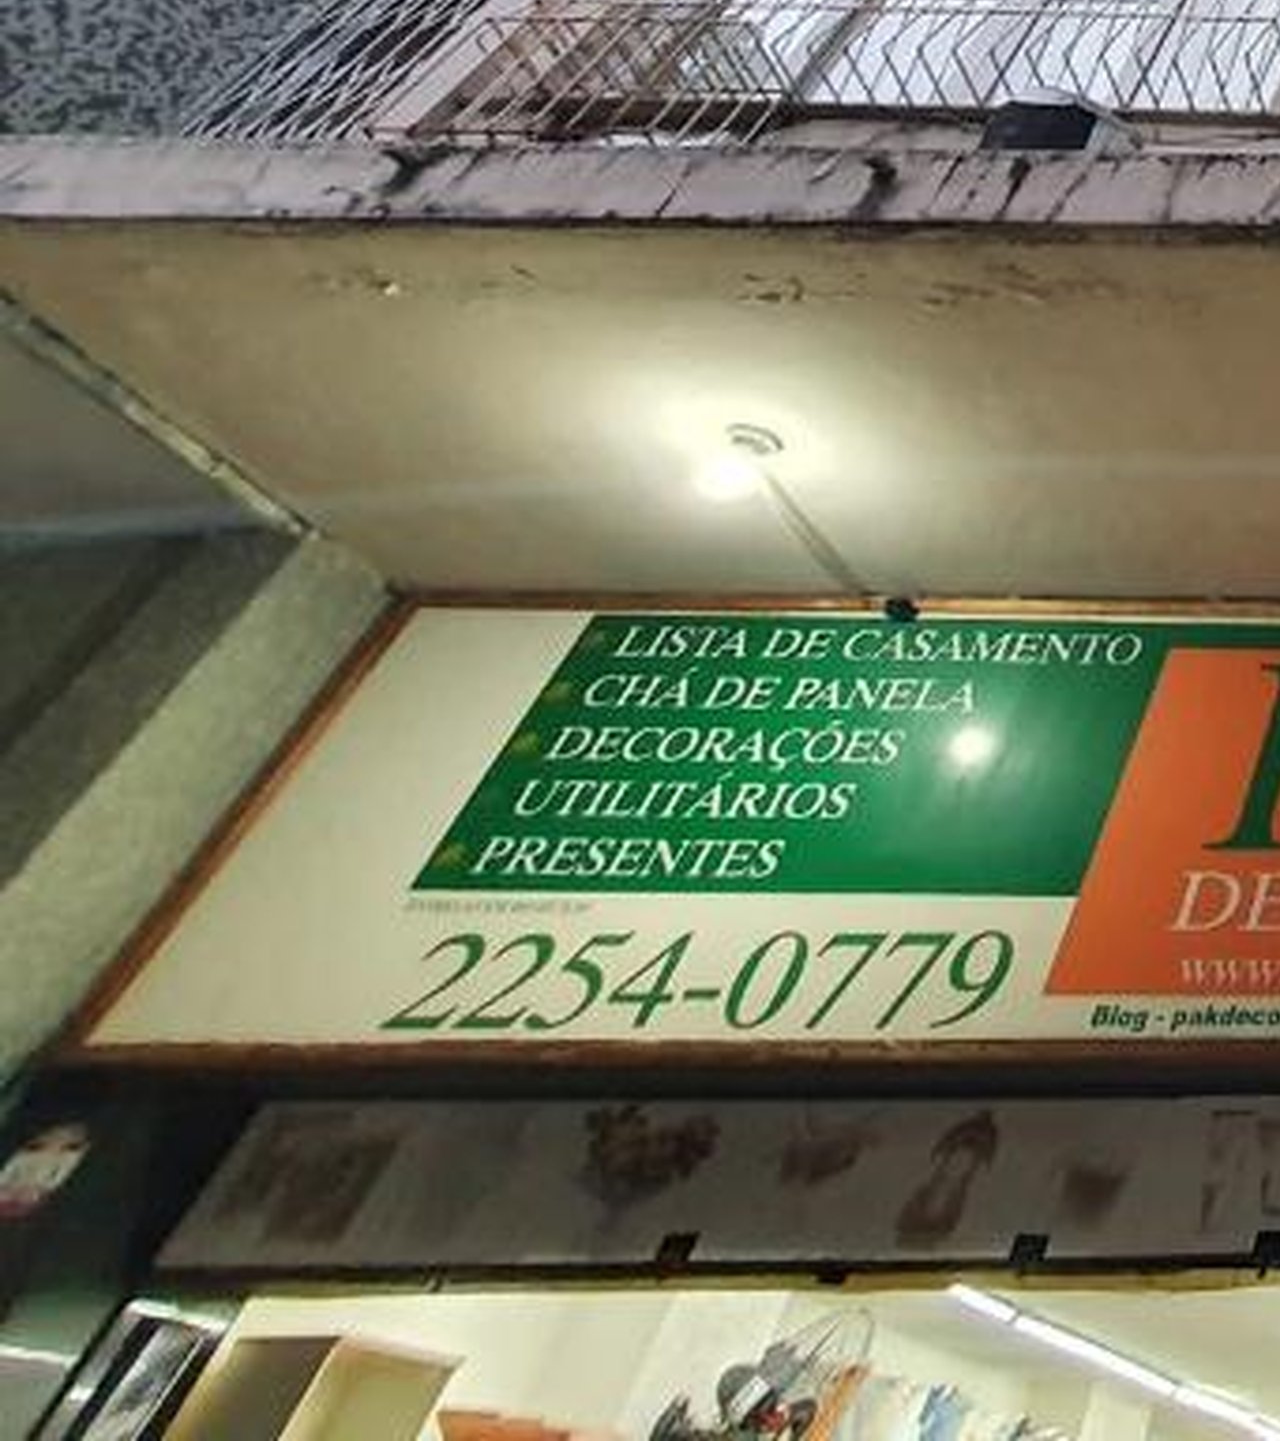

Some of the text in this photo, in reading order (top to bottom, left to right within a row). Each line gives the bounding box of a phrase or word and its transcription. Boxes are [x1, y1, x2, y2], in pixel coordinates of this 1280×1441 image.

[614, 626, 1143, 665] LISTA DE CASAMENTO
[583, 666, 977, 711] CHÁ DE PANELA
[513, 771, 858, 819] UTILITÁRIOS
[469, 837, 785, 877] PRESENTES
[381, 931, 1015, 1030] 2254-0779
[1091, 1005, 1149, 1030] Blog
